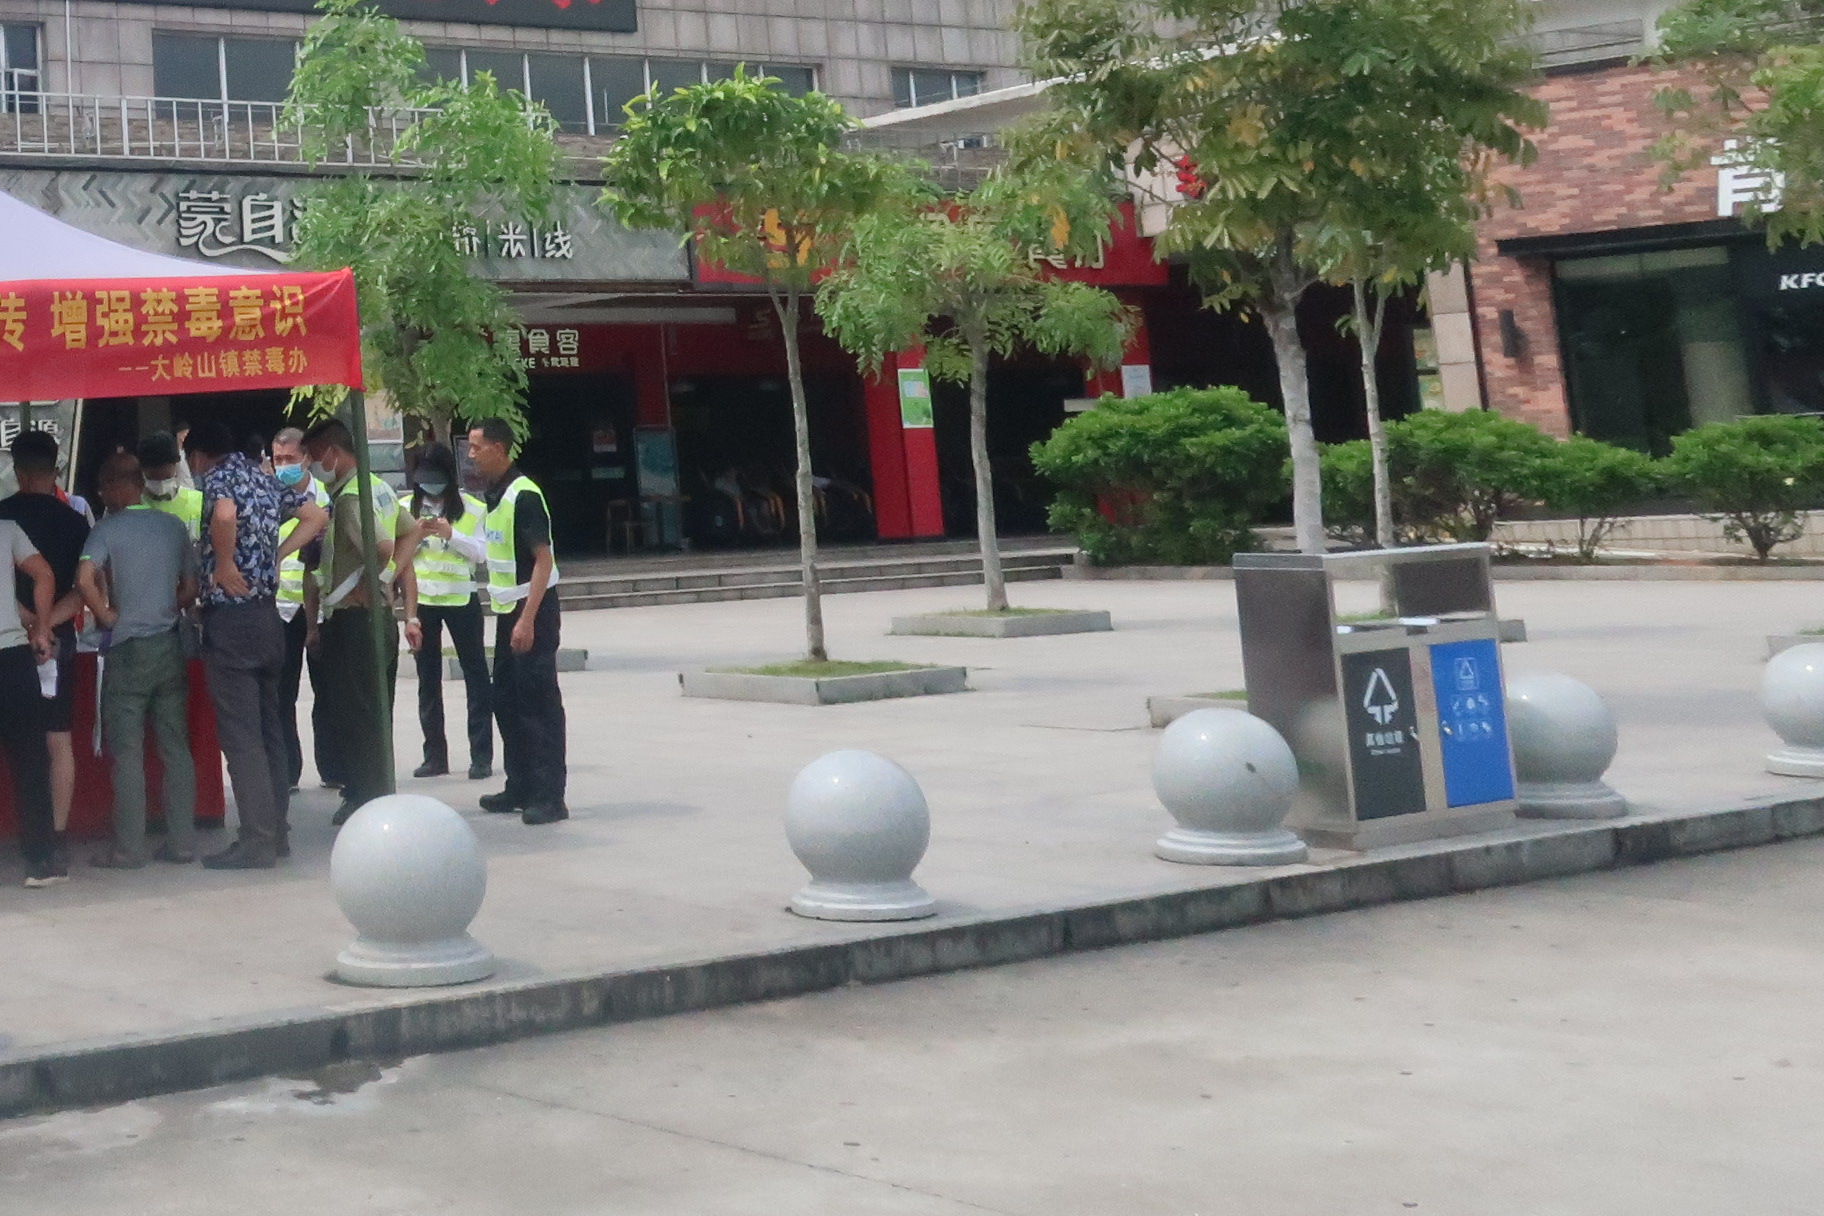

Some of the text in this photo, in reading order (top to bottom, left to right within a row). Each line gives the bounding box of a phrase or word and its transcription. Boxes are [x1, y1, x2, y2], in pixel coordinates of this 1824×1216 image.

[176, 189, 306, 264] 蒙自
[50, 285, 308, 349] 增强禁毒意识
